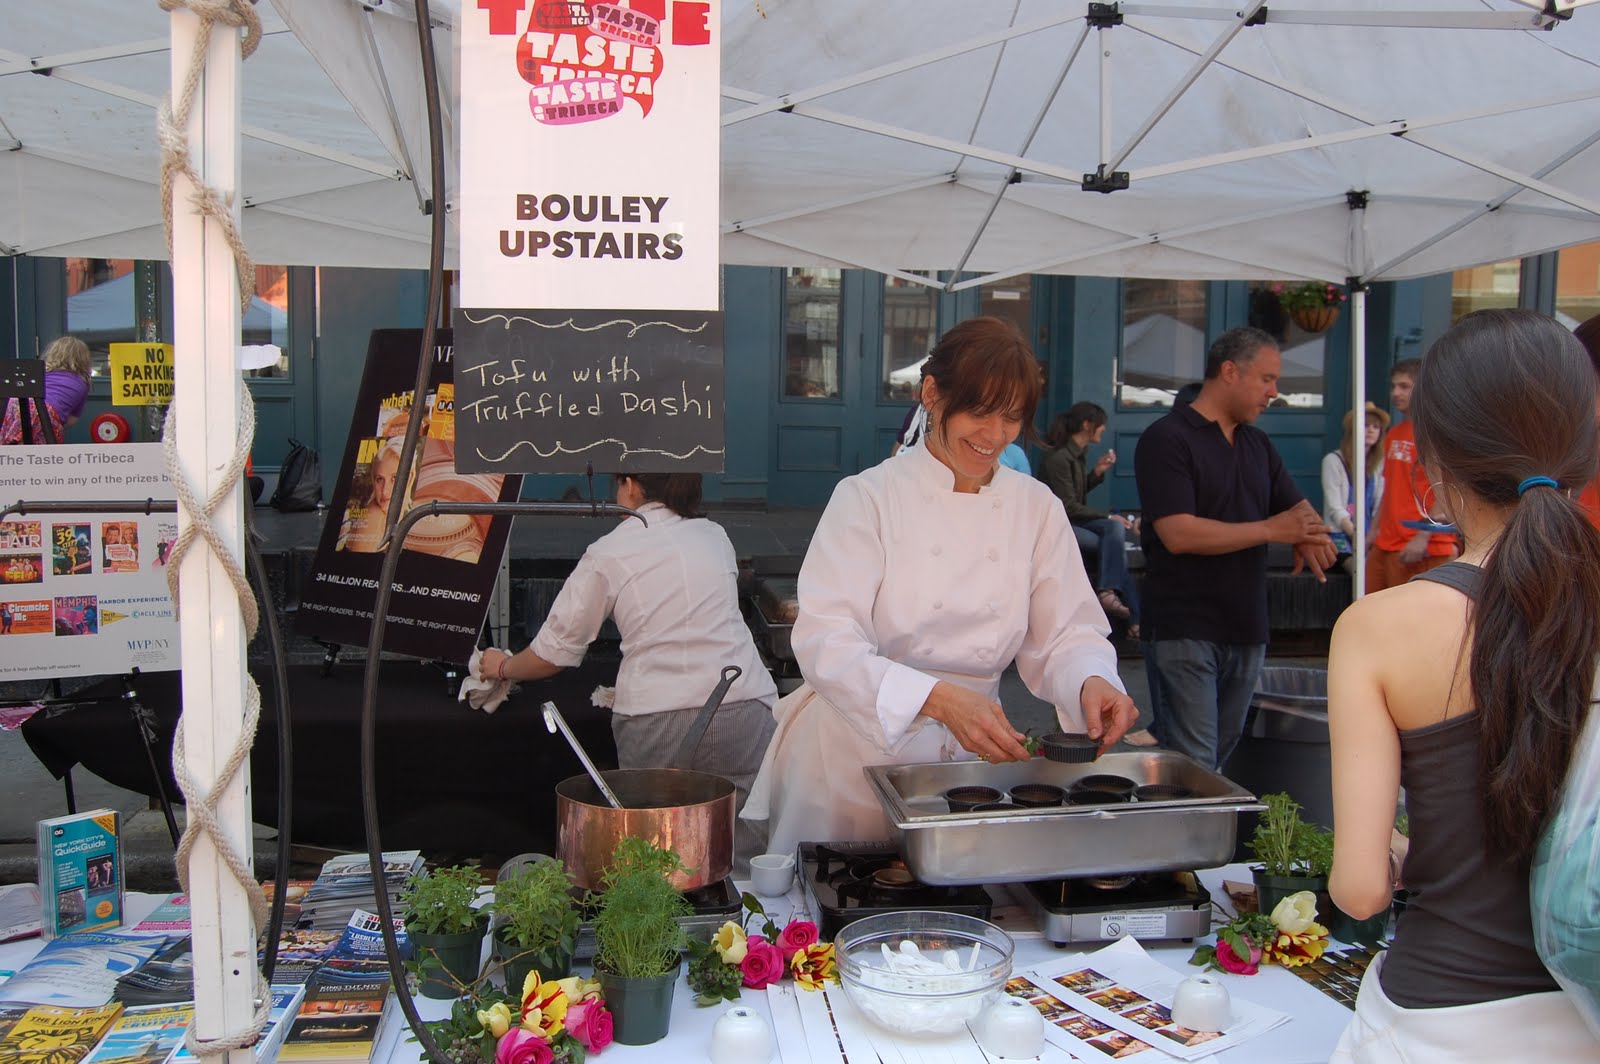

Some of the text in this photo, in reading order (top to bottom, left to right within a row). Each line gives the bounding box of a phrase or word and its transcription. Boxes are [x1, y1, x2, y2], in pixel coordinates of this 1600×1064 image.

[596, 4, 658, 36] TASTE
[526, 31, 655, 73] TASTE
[532, 81, 617, 106] TASTE
[545, 101, 619, 120] TRIBECA
[516, 193, 669, 223] BOULEY
[500, 230, 684, 260] UPSTAIRS
[145, 348, 165, 364] NO
[123, 365, 174, 381] PARKING
[462, 356, 640, 387] Tofu with
[462, 380, 712, 423] Truffled Dashi
[0, 453, 135, 465] The Taste of Tribeca
[30, 477, 42, 486] to
[44, 476, 64, 485] win
[67, 477, 88, 487] any
[91, 475, 102, 484] of
[105, 475, 122, 484] the
[125, 474, 159, 485] prizes
[0, 534, 40, 548] HAIR
[57, 529, 73, 545] 39
[316, 572, 327, 581] 34
[327, 574, 361, 586] MILLION
[430, 589, 481, 603] SPENDING!
[55, 597, 97, 608] MEMPHIS
[312, 603, 329, 612] RIGHT
[355, 610, 366, 618] THE
[416, 620, 427, 628] THE
[428, 621, 447, 630] RIGHT
[55, 840, 106, 857] QuickGuide
[51, 1017, 80, 1026] LION
[81, 1014, 110, 1025] KING
